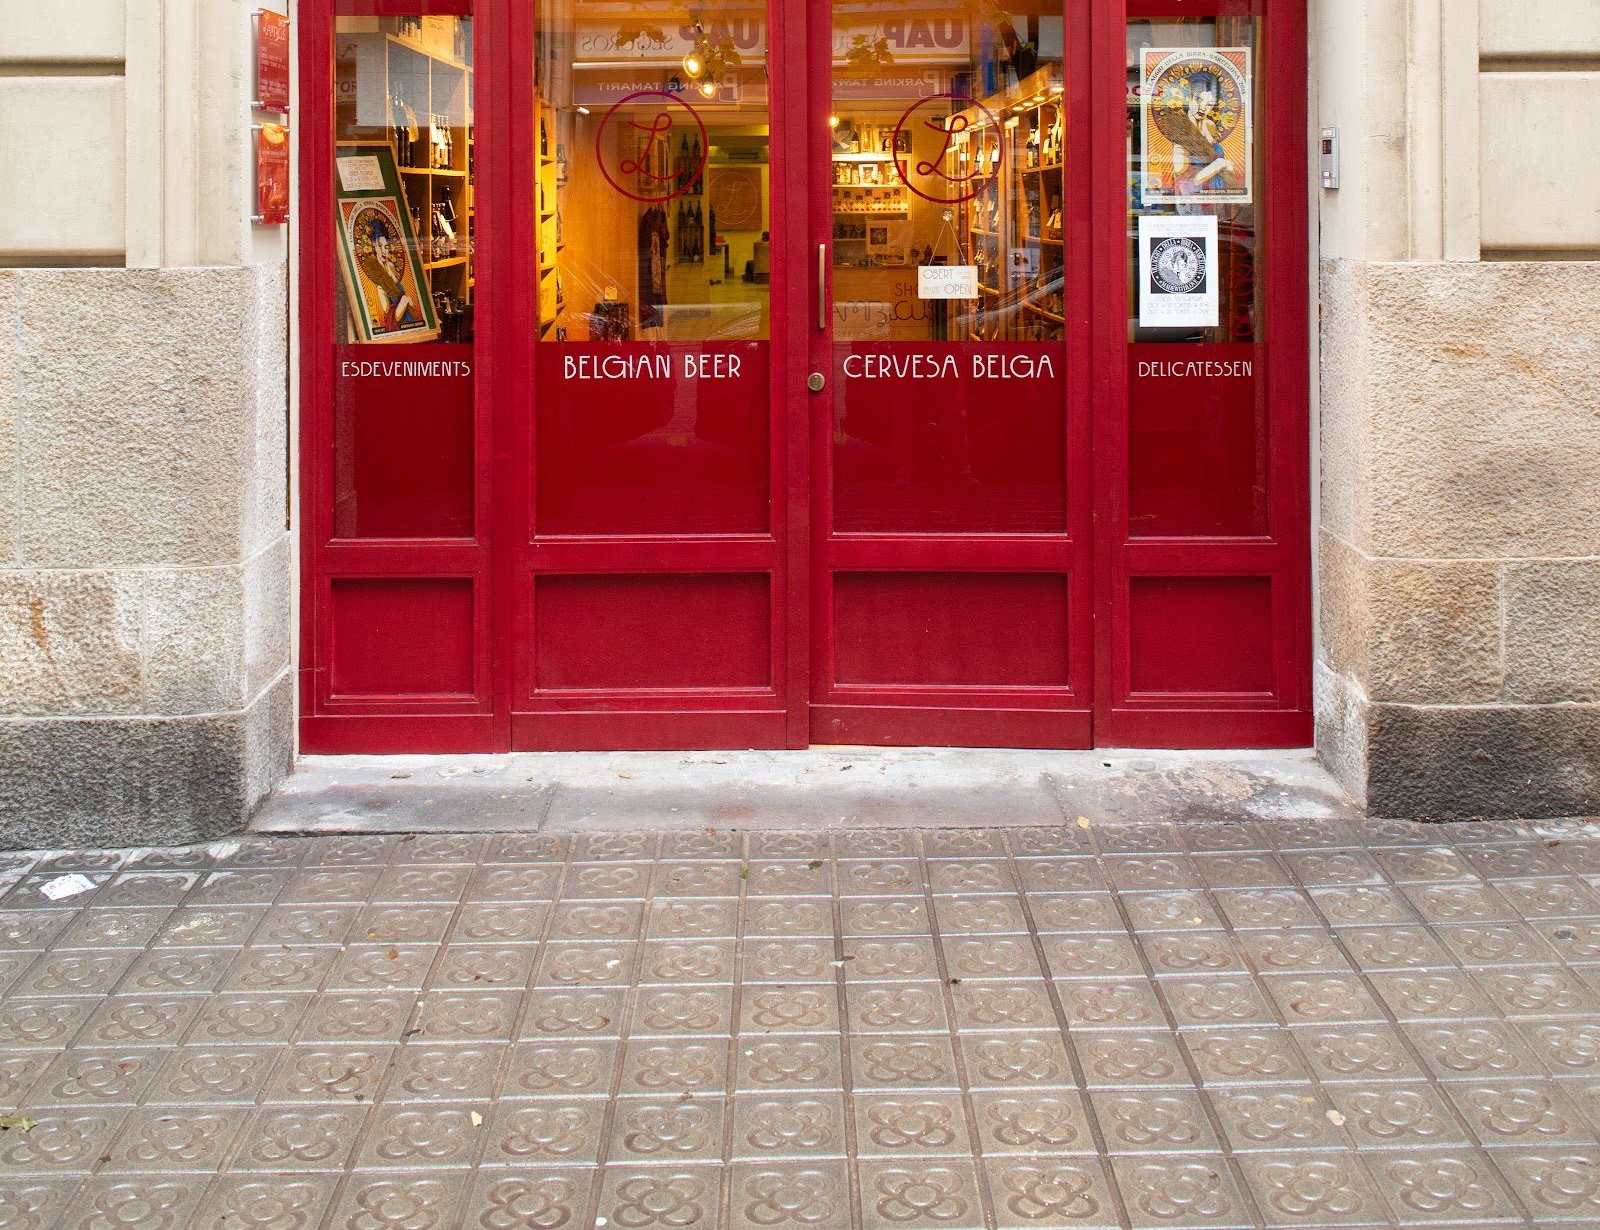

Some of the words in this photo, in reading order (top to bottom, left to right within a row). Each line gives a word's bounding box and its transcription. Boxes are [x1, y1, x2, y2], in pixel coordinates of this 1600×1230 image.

[943, 283, 973, 295] OPEN
[341, 361, 471, 378] ESDEVENIMENTS
[563, 354, 671, 380] BELGIAN
[684, 354, 742, 379] BEER
[843, 354, 959, 379] CERVESA
[972, 354, 1055, 379] BELGA
[1138, 361, 1252, 377] DELICATESSEN
